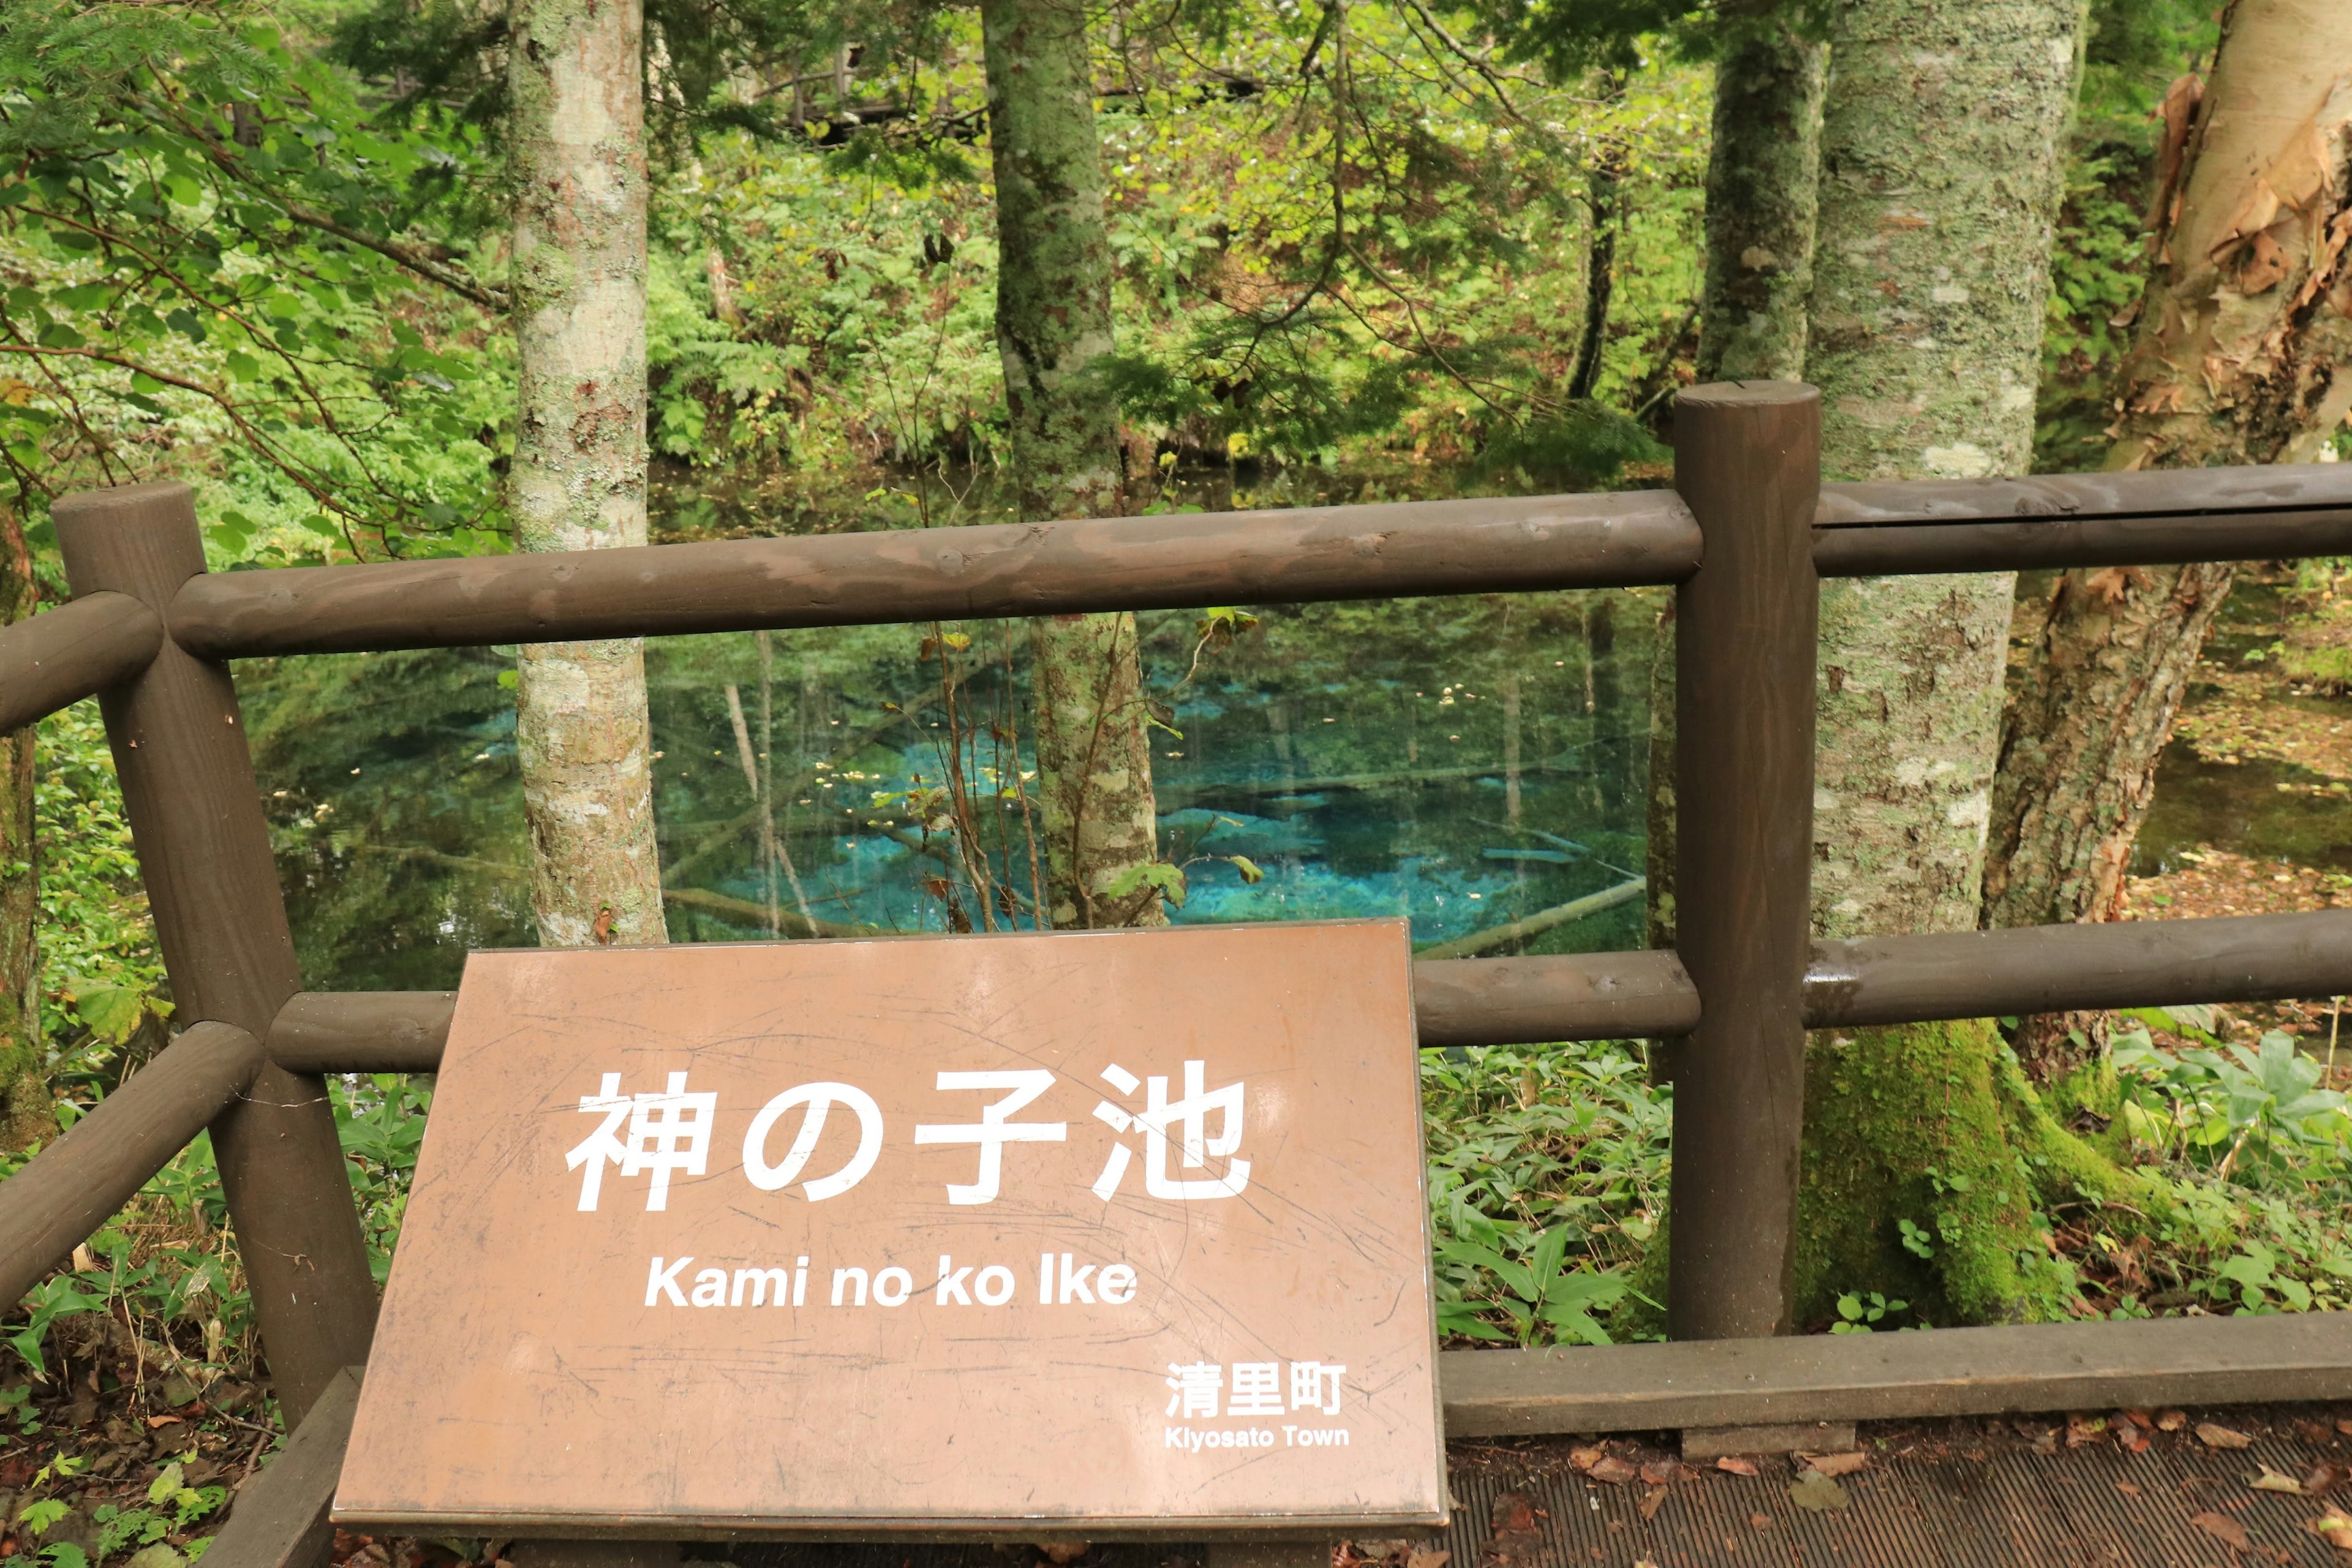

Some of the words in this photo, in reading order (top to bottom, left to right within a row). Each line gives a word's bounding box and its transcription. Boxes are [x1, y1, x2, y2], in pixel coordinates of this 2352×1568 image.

[565, 1060, 1251, 1212] 神の子池
[644, 1256, 809, 1308] Kami
[831, 1266, 913, 1308] no
[936, 1254, 1016, 1306] ko
[1039, 1253, 1137, 1305] Ike
[1164, 1360, 1347, 1419] 清里町
[1281, 1424, 1350, 1447] Town
